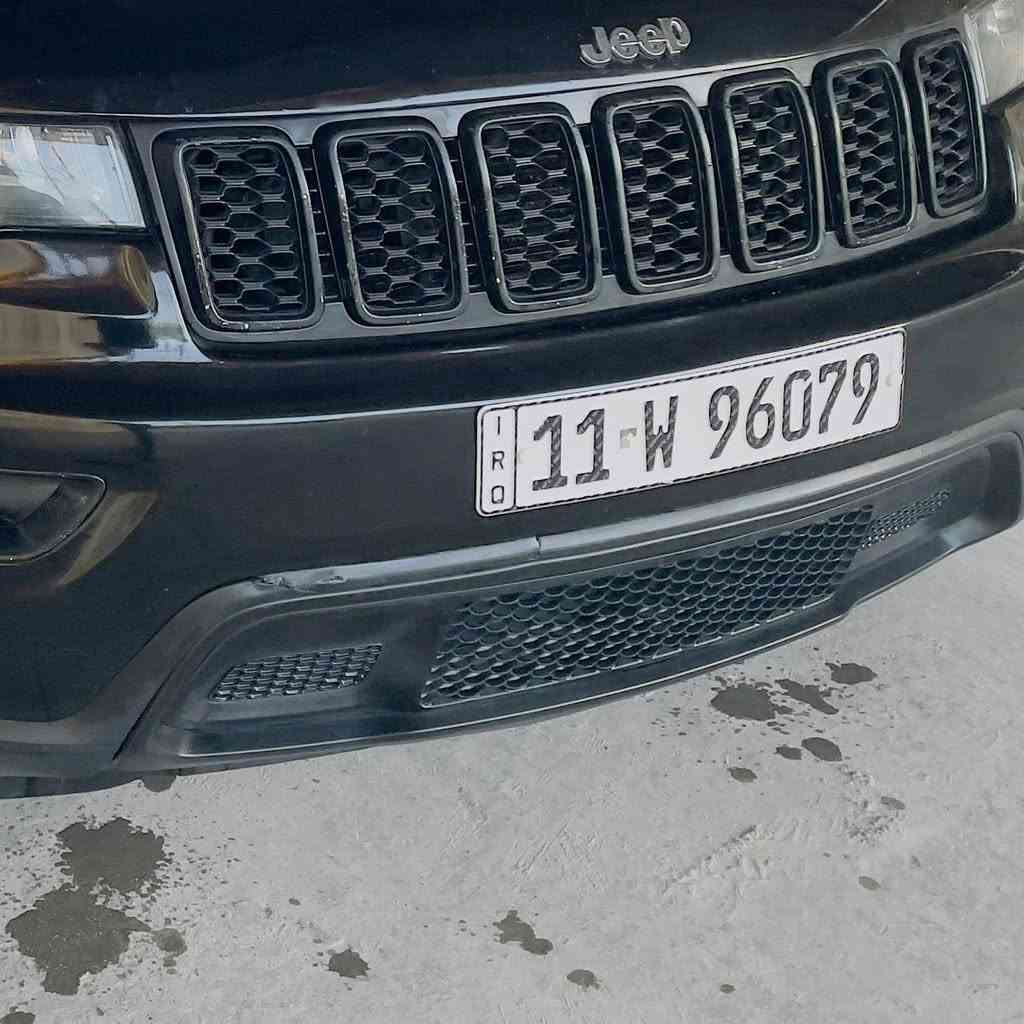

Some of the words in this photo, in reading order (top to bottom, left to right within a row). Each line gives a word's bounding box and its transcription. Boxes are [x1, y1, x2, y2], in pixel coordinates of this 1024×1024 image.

[579, 17, 691, 66] Jeep
[532, 408, 609, 491] 11
[644, 396, 678, 472] W
[709, 353, 880, 459] 96079
